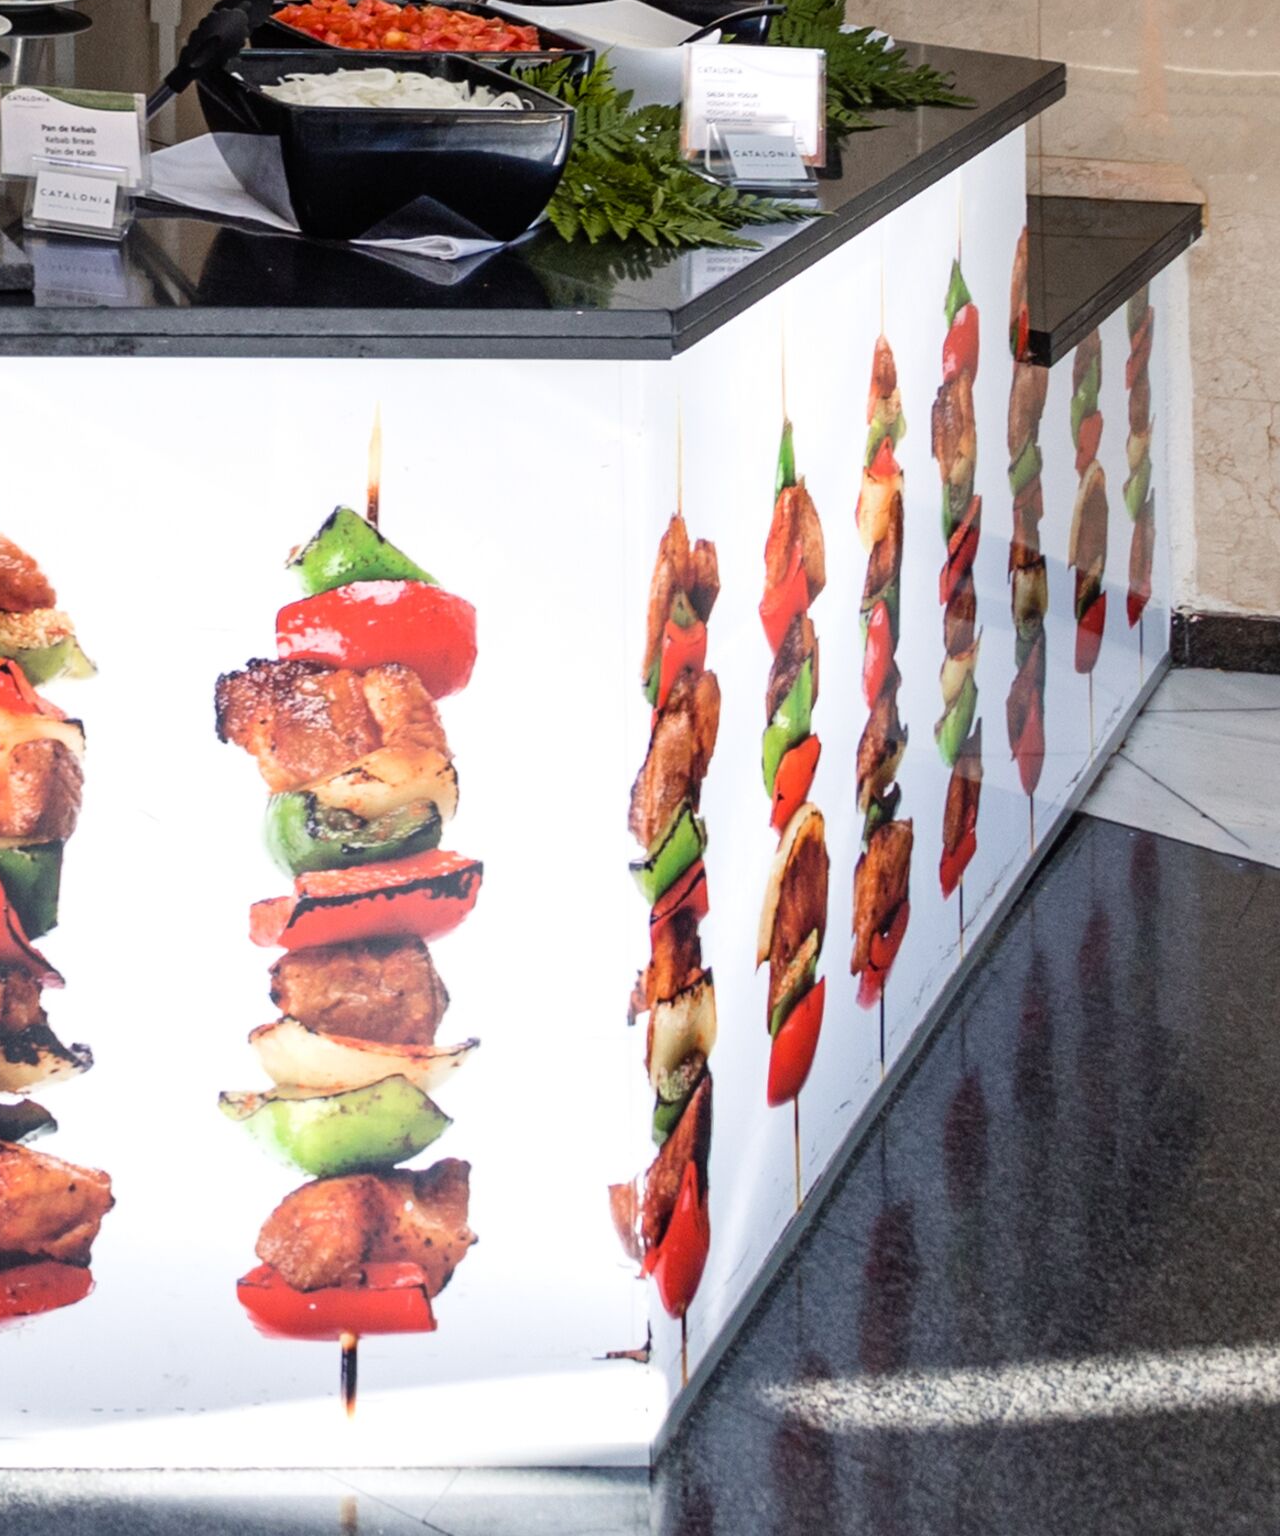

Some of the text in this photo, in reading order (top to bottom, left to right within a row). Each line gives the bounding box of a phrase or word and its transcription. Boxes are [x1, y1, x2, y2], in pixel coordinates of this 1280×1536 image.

[41, 124, 56, 132] Pan
[71, 126, 97, 134] Kebab
[45, 136, 70, 144] Kebab
[733, 149, 798, 158] CATALONIA
[39, 187, 112, 205] CATALONIA
